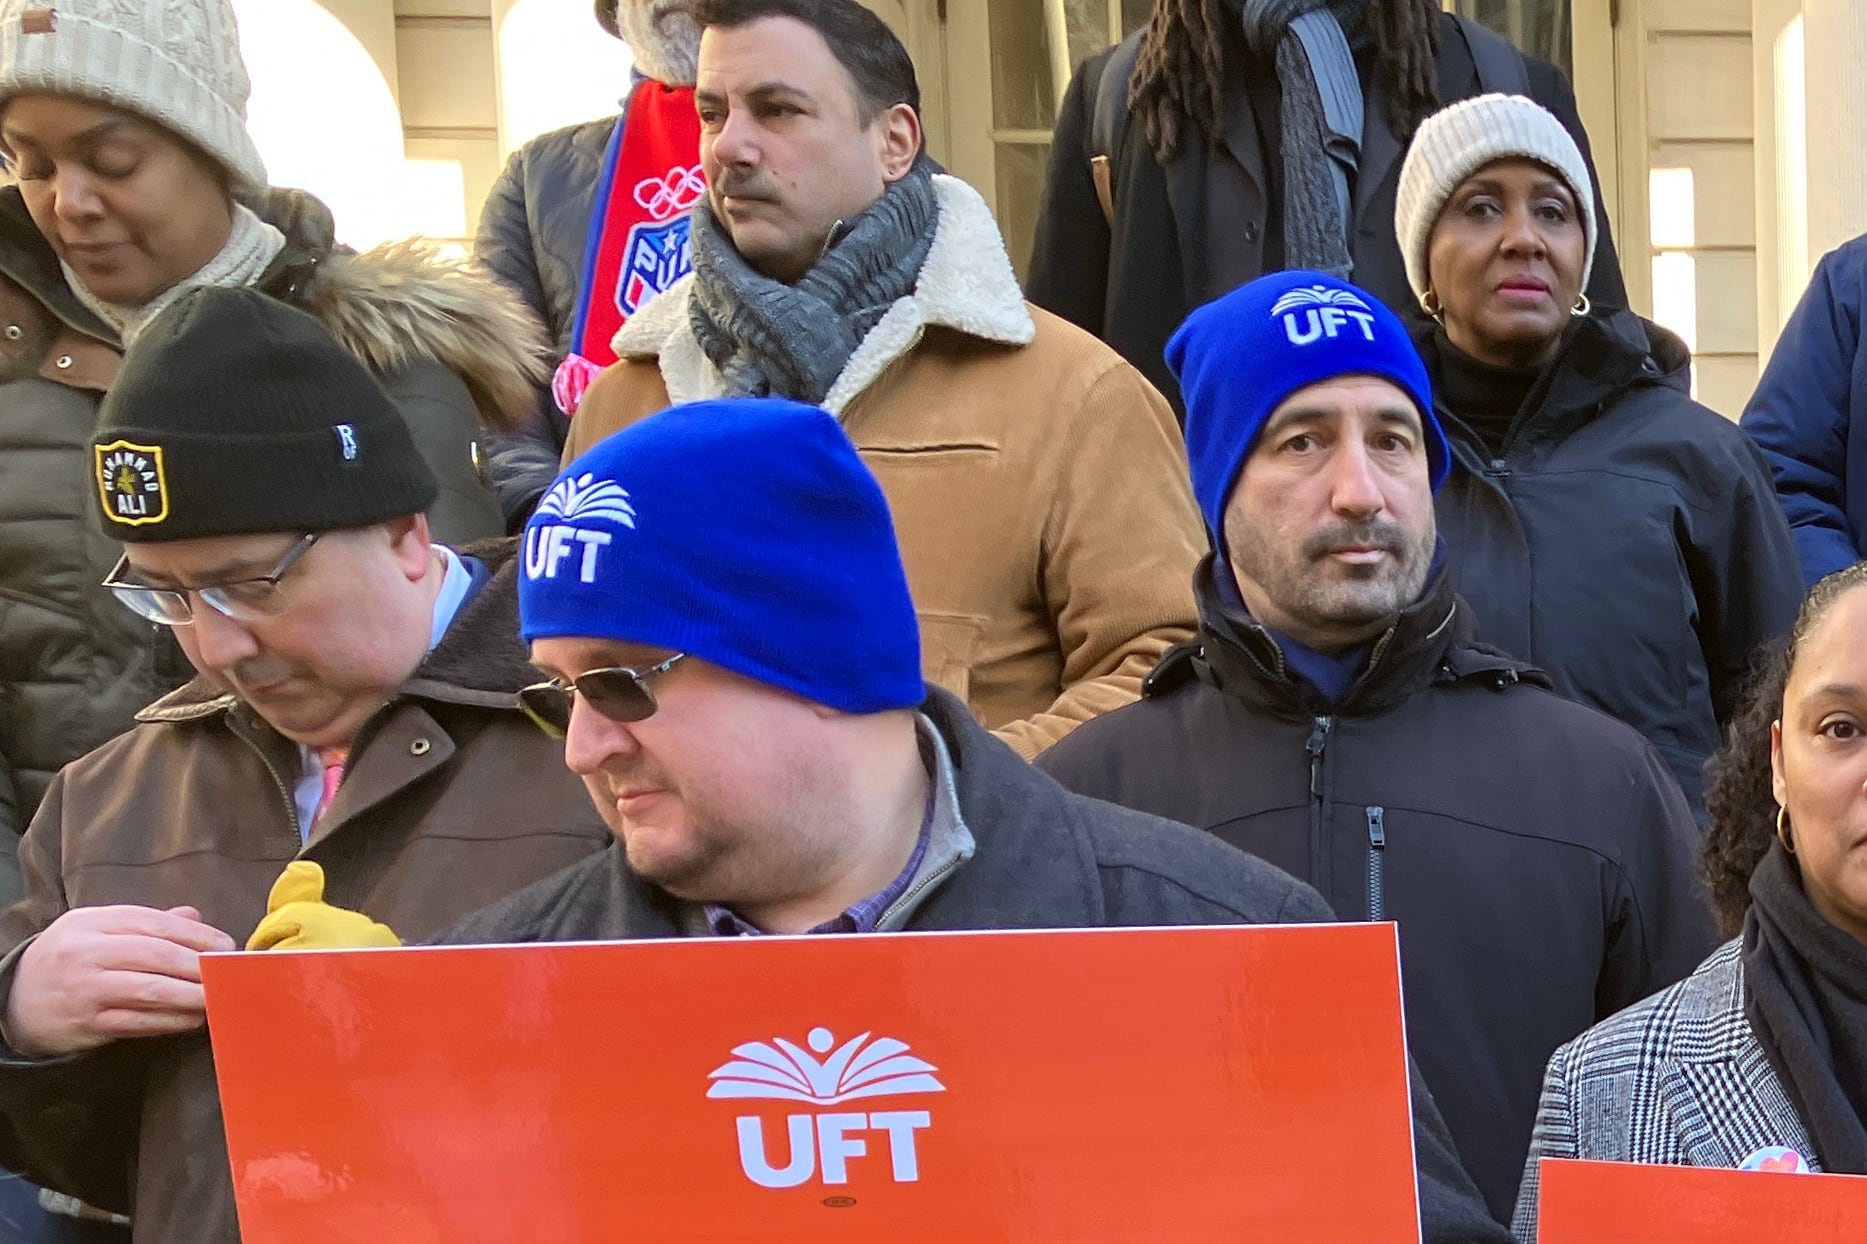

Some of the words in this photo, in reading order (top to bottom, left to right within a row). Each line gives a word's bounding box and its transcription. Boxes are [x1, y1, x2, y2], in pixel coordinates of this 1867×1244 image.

[1283, 306, 1376, 346] UFT
[117, 494, 147, 514] ALI
[526, 525, 612, 583] UFT
[736, 1110, 931, 1188] UFT
